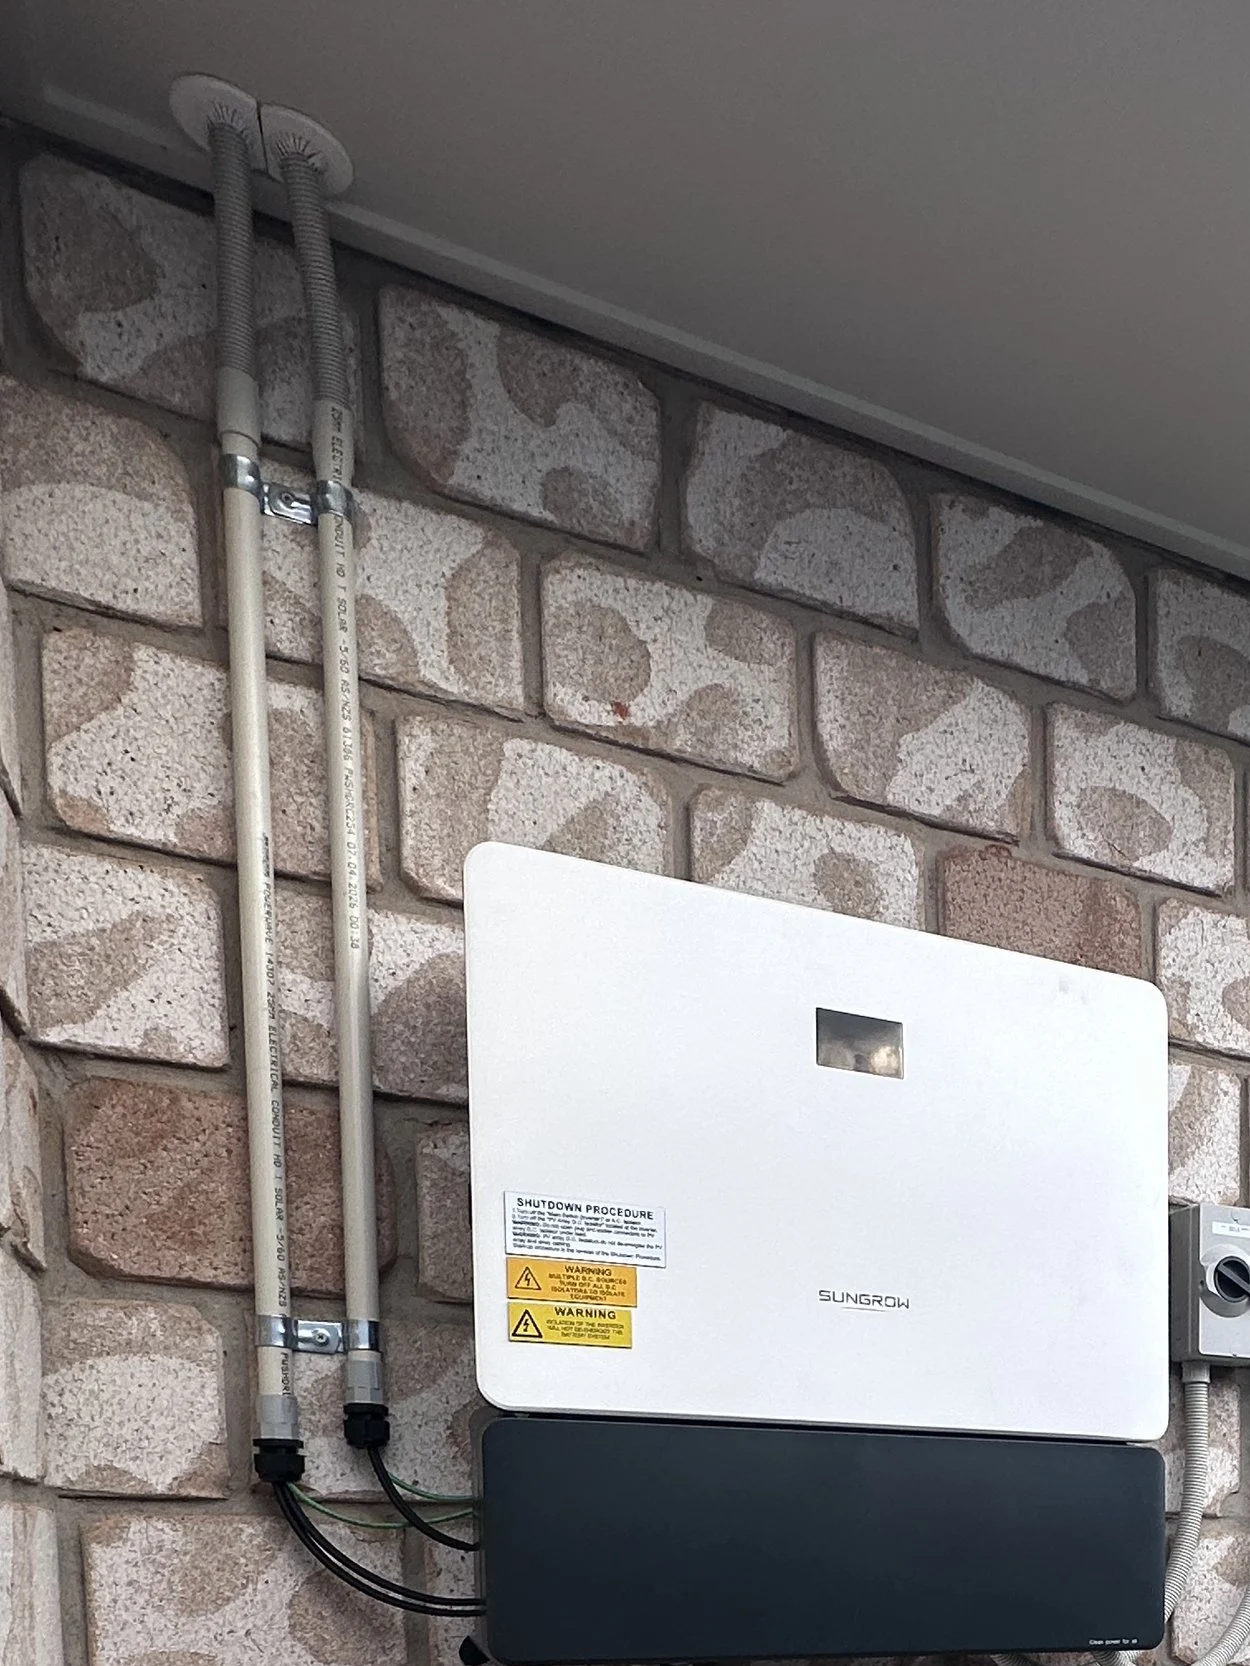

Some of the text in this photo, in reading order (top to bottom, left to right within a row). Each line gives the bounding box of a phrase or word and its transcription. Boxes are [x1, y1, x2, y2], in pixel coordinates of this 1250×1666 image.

[337, 597, 349, 633] SOLAR
[268, 1026, 279, 1092] ELECTRICAL
[271, 1100, 281, 1148] CONDUIT
[275, 1188, 284, 1221] SOLAR
[517, 1197, 582, 1212] SHUTDOWN
[586, 1204, 654, 1220] PROCEDURE
[565, 1265, 612, 1276] WARNING
[554, 1306, 616, 1320] WARNING
[818, 1289, 909, 1309] SUNGROW
